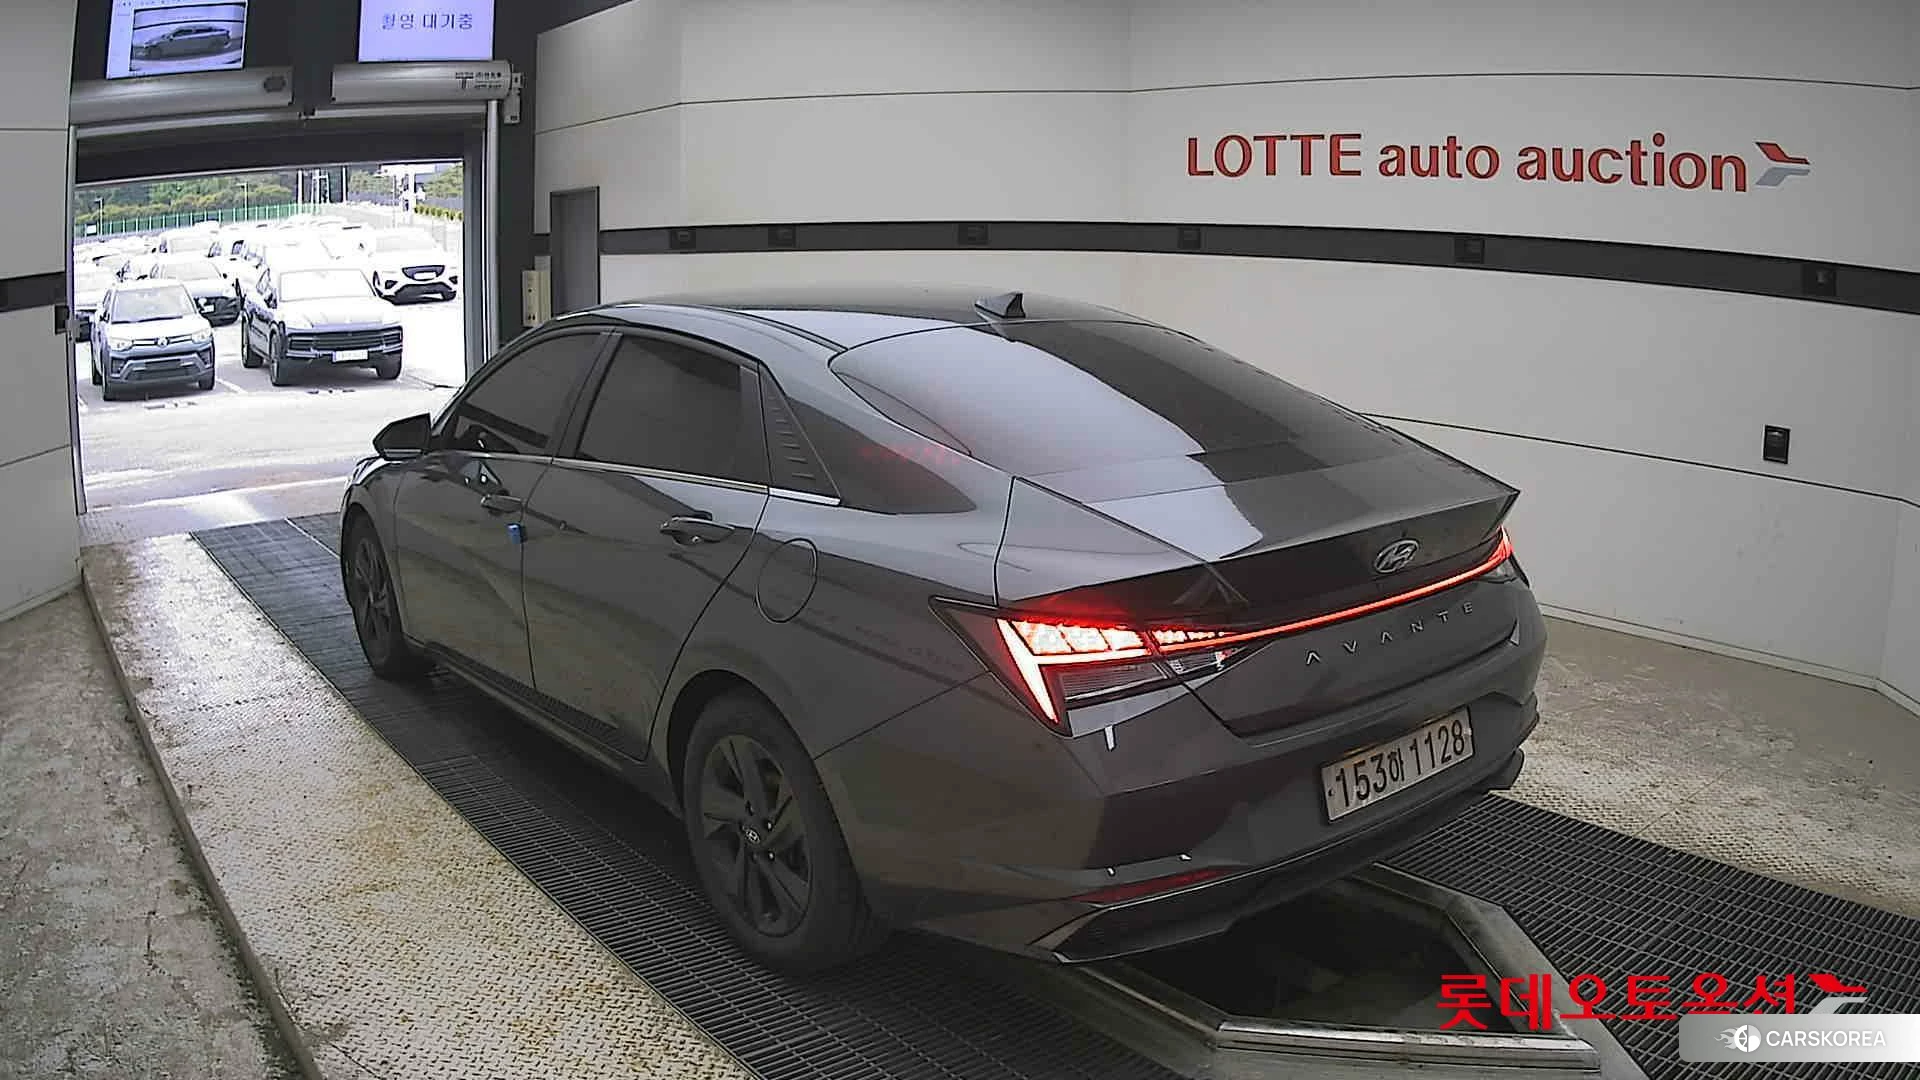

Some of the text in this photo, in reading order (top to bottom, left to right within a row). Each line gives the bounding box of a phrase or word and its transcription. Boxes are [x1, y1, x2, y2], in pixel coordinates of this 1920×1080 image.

[1187, 132, 1748, 192] LOTTE auto auction
[1305, 601, 1473, 665] AVANTE
[1410, 719, 1465, 776] 1128
